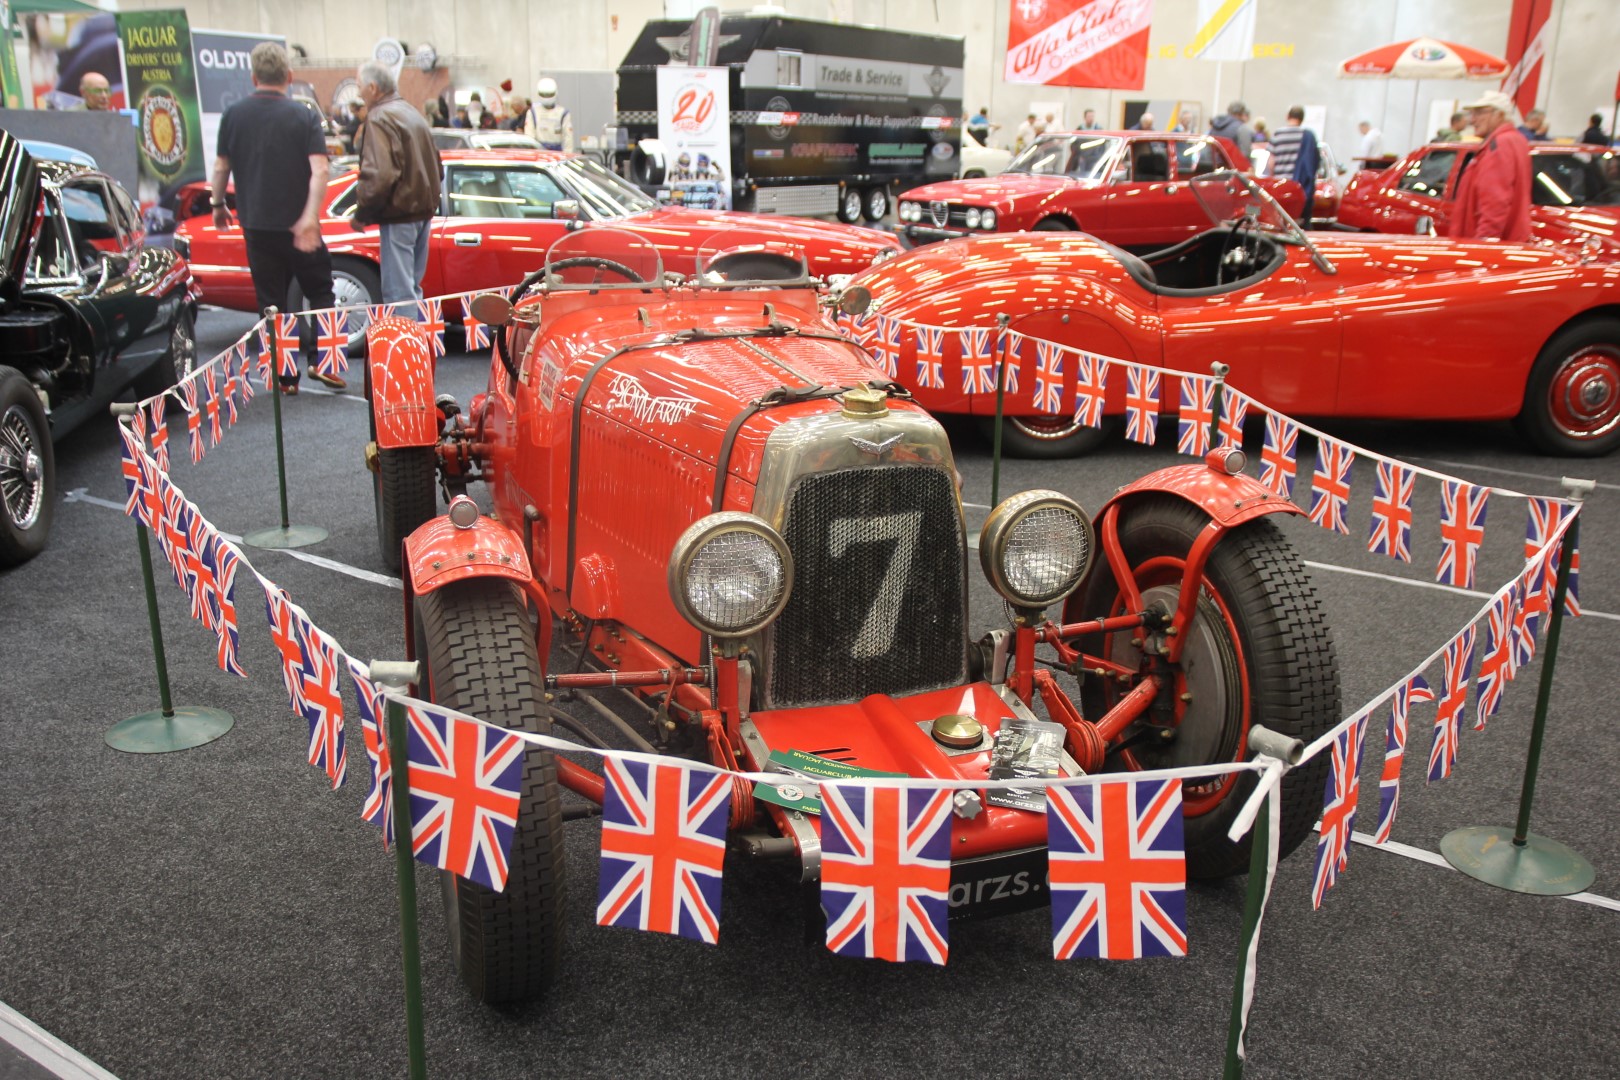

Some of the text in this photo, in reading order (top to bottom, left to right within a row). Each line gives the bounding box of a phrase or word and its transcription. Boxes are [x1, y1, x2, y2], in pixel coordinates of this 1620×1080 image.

[128, 26, 177, 49] JAGUAR
[162, 52, 182, 66] CLUB
[200, 49, 252, 70] OLDTI
[142, 69, 172, 81] AUSTRIA
[821, 66, 903, 87] Trade & Service
[672, 88, 715, 124] 20
[812, 113, 855, 126] Roadshow
[856, 114, 863, 126] &
[864, 115, 882, 126] Race
[883, 115, 912, 129] Support
[830, 512, 923, 659] 7
[948, 871, 1050, 907] arzs.
